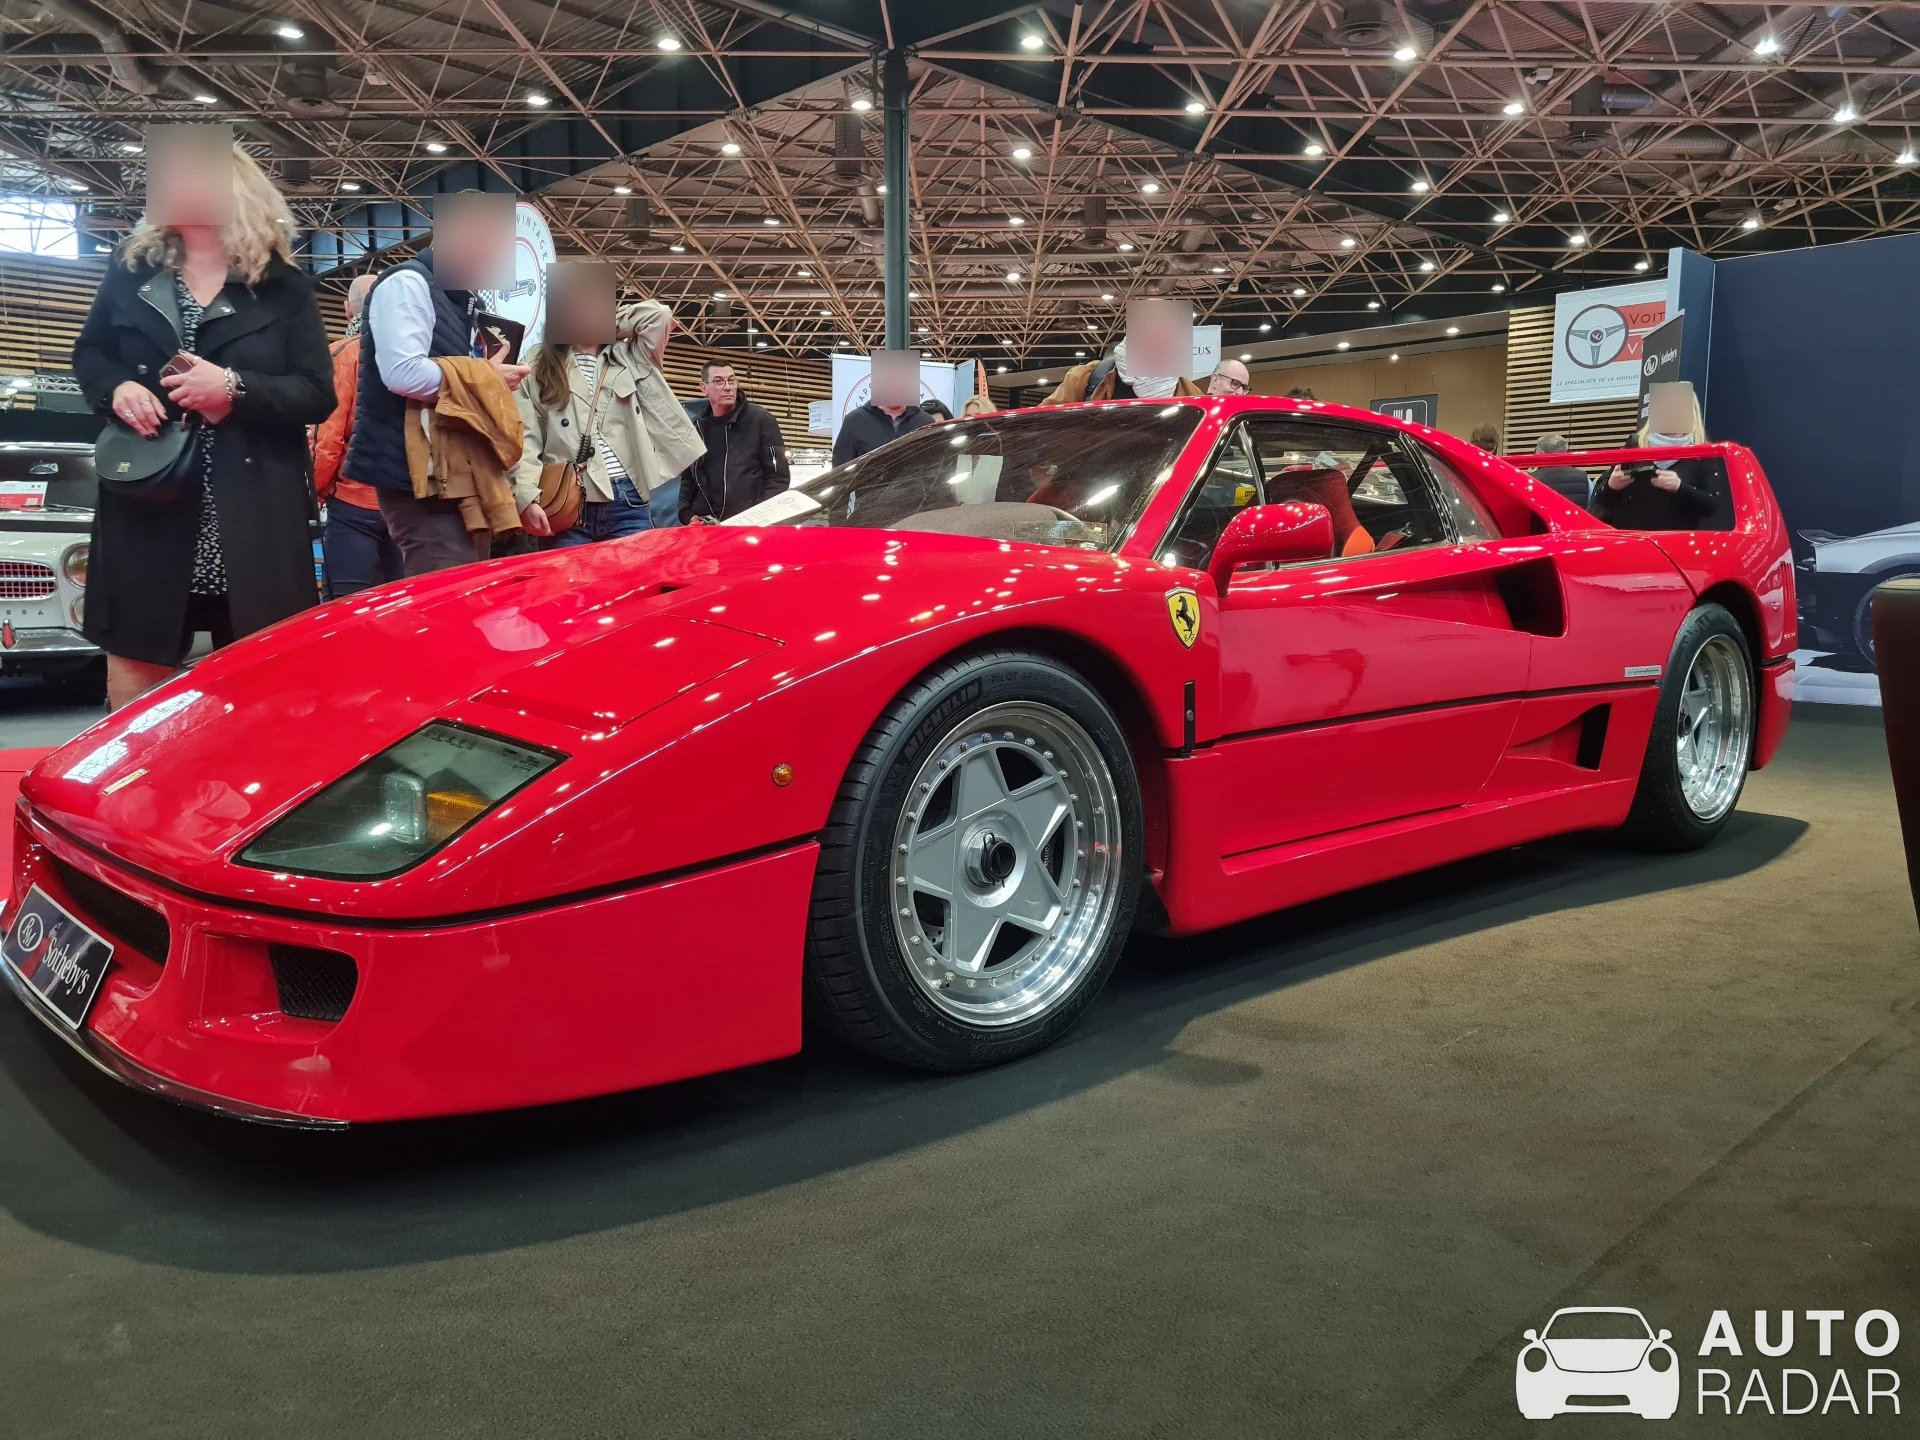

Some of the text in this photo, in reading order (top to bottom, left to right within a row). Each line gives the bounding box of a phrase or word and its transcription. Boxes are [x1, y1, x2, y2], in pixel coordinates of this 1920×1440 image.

[516, 214, 549, 261] VINTAGE
[904, 682, 980, 761] MICHELIN
[991, 671, 1019, 683] PILOT
[42, 937, 91, 996] Sotheby's
